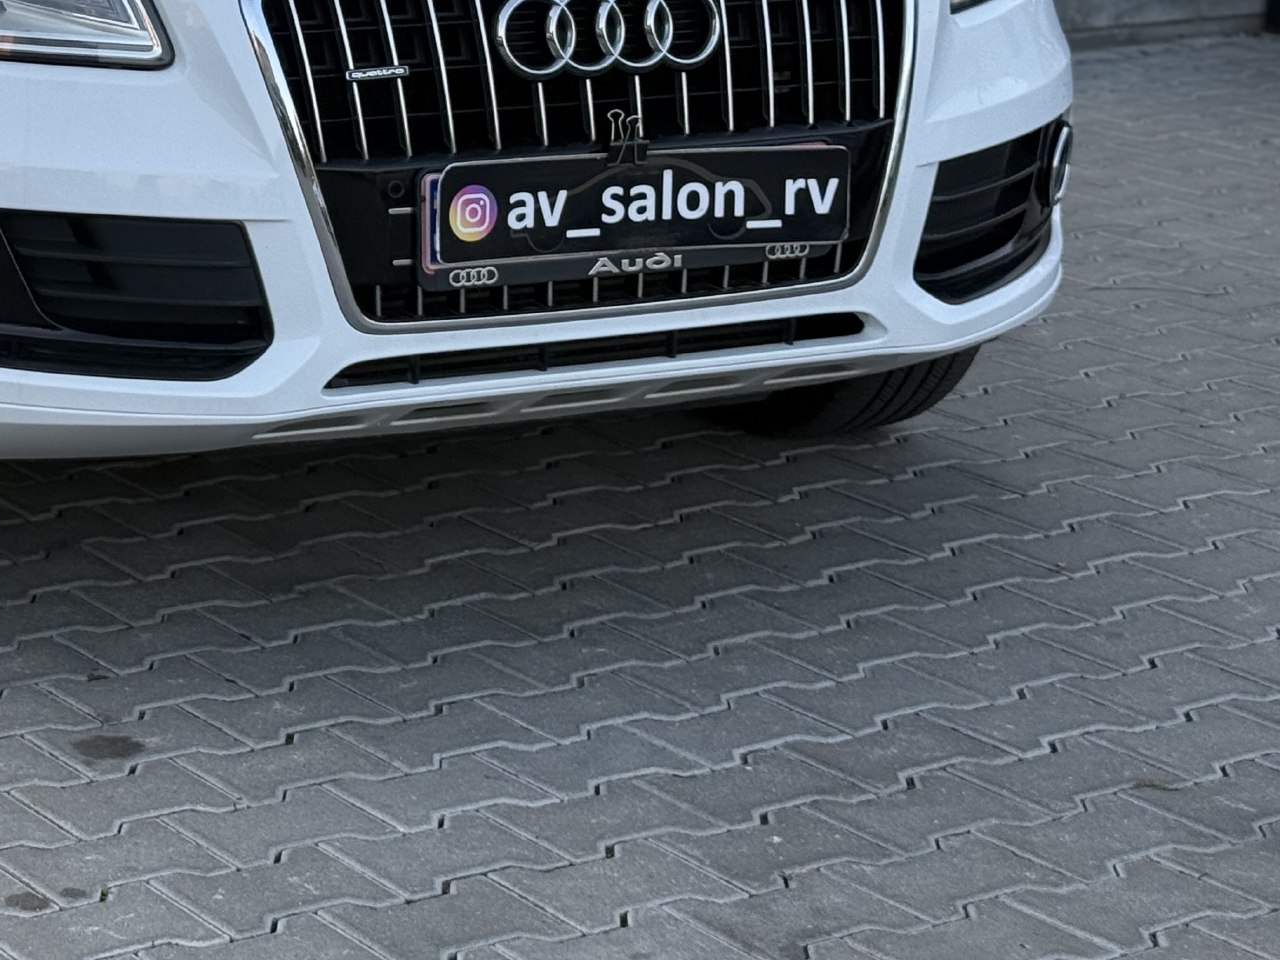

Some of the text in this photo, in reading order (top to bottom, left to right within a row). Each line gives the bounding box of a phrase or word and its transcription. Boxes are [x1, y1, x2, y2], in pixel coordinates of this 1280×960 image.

[350, 67, 406, 79] quattro
[506, 168, 840, 239] av_salon_rv
[587, 251, 683, 276] Audi
